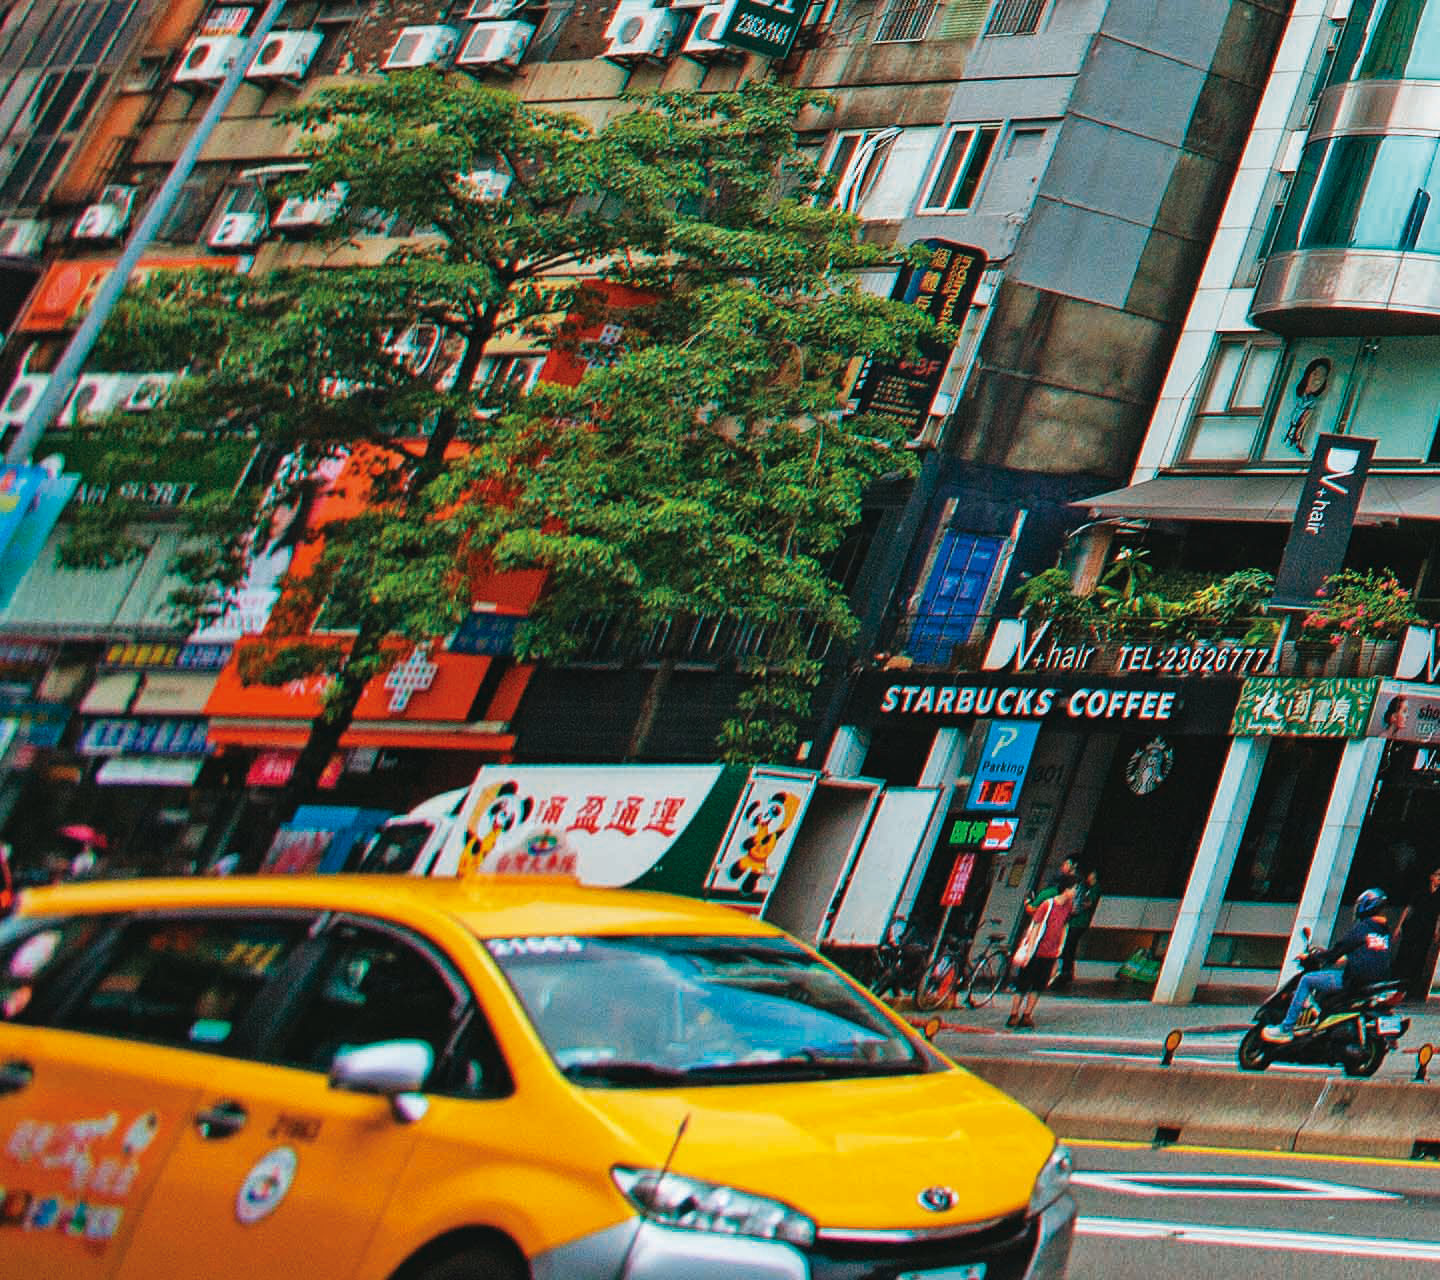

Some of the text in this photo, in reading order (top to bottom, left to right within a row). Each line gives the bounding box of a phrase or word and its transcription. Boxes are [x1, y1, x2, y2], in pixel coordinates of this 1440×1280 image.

[880, 684, 1177, 721] STARBUCKS COFFEE
[991, 726, 1018, 758] P
[981, 759, 1025, 777] Parking
